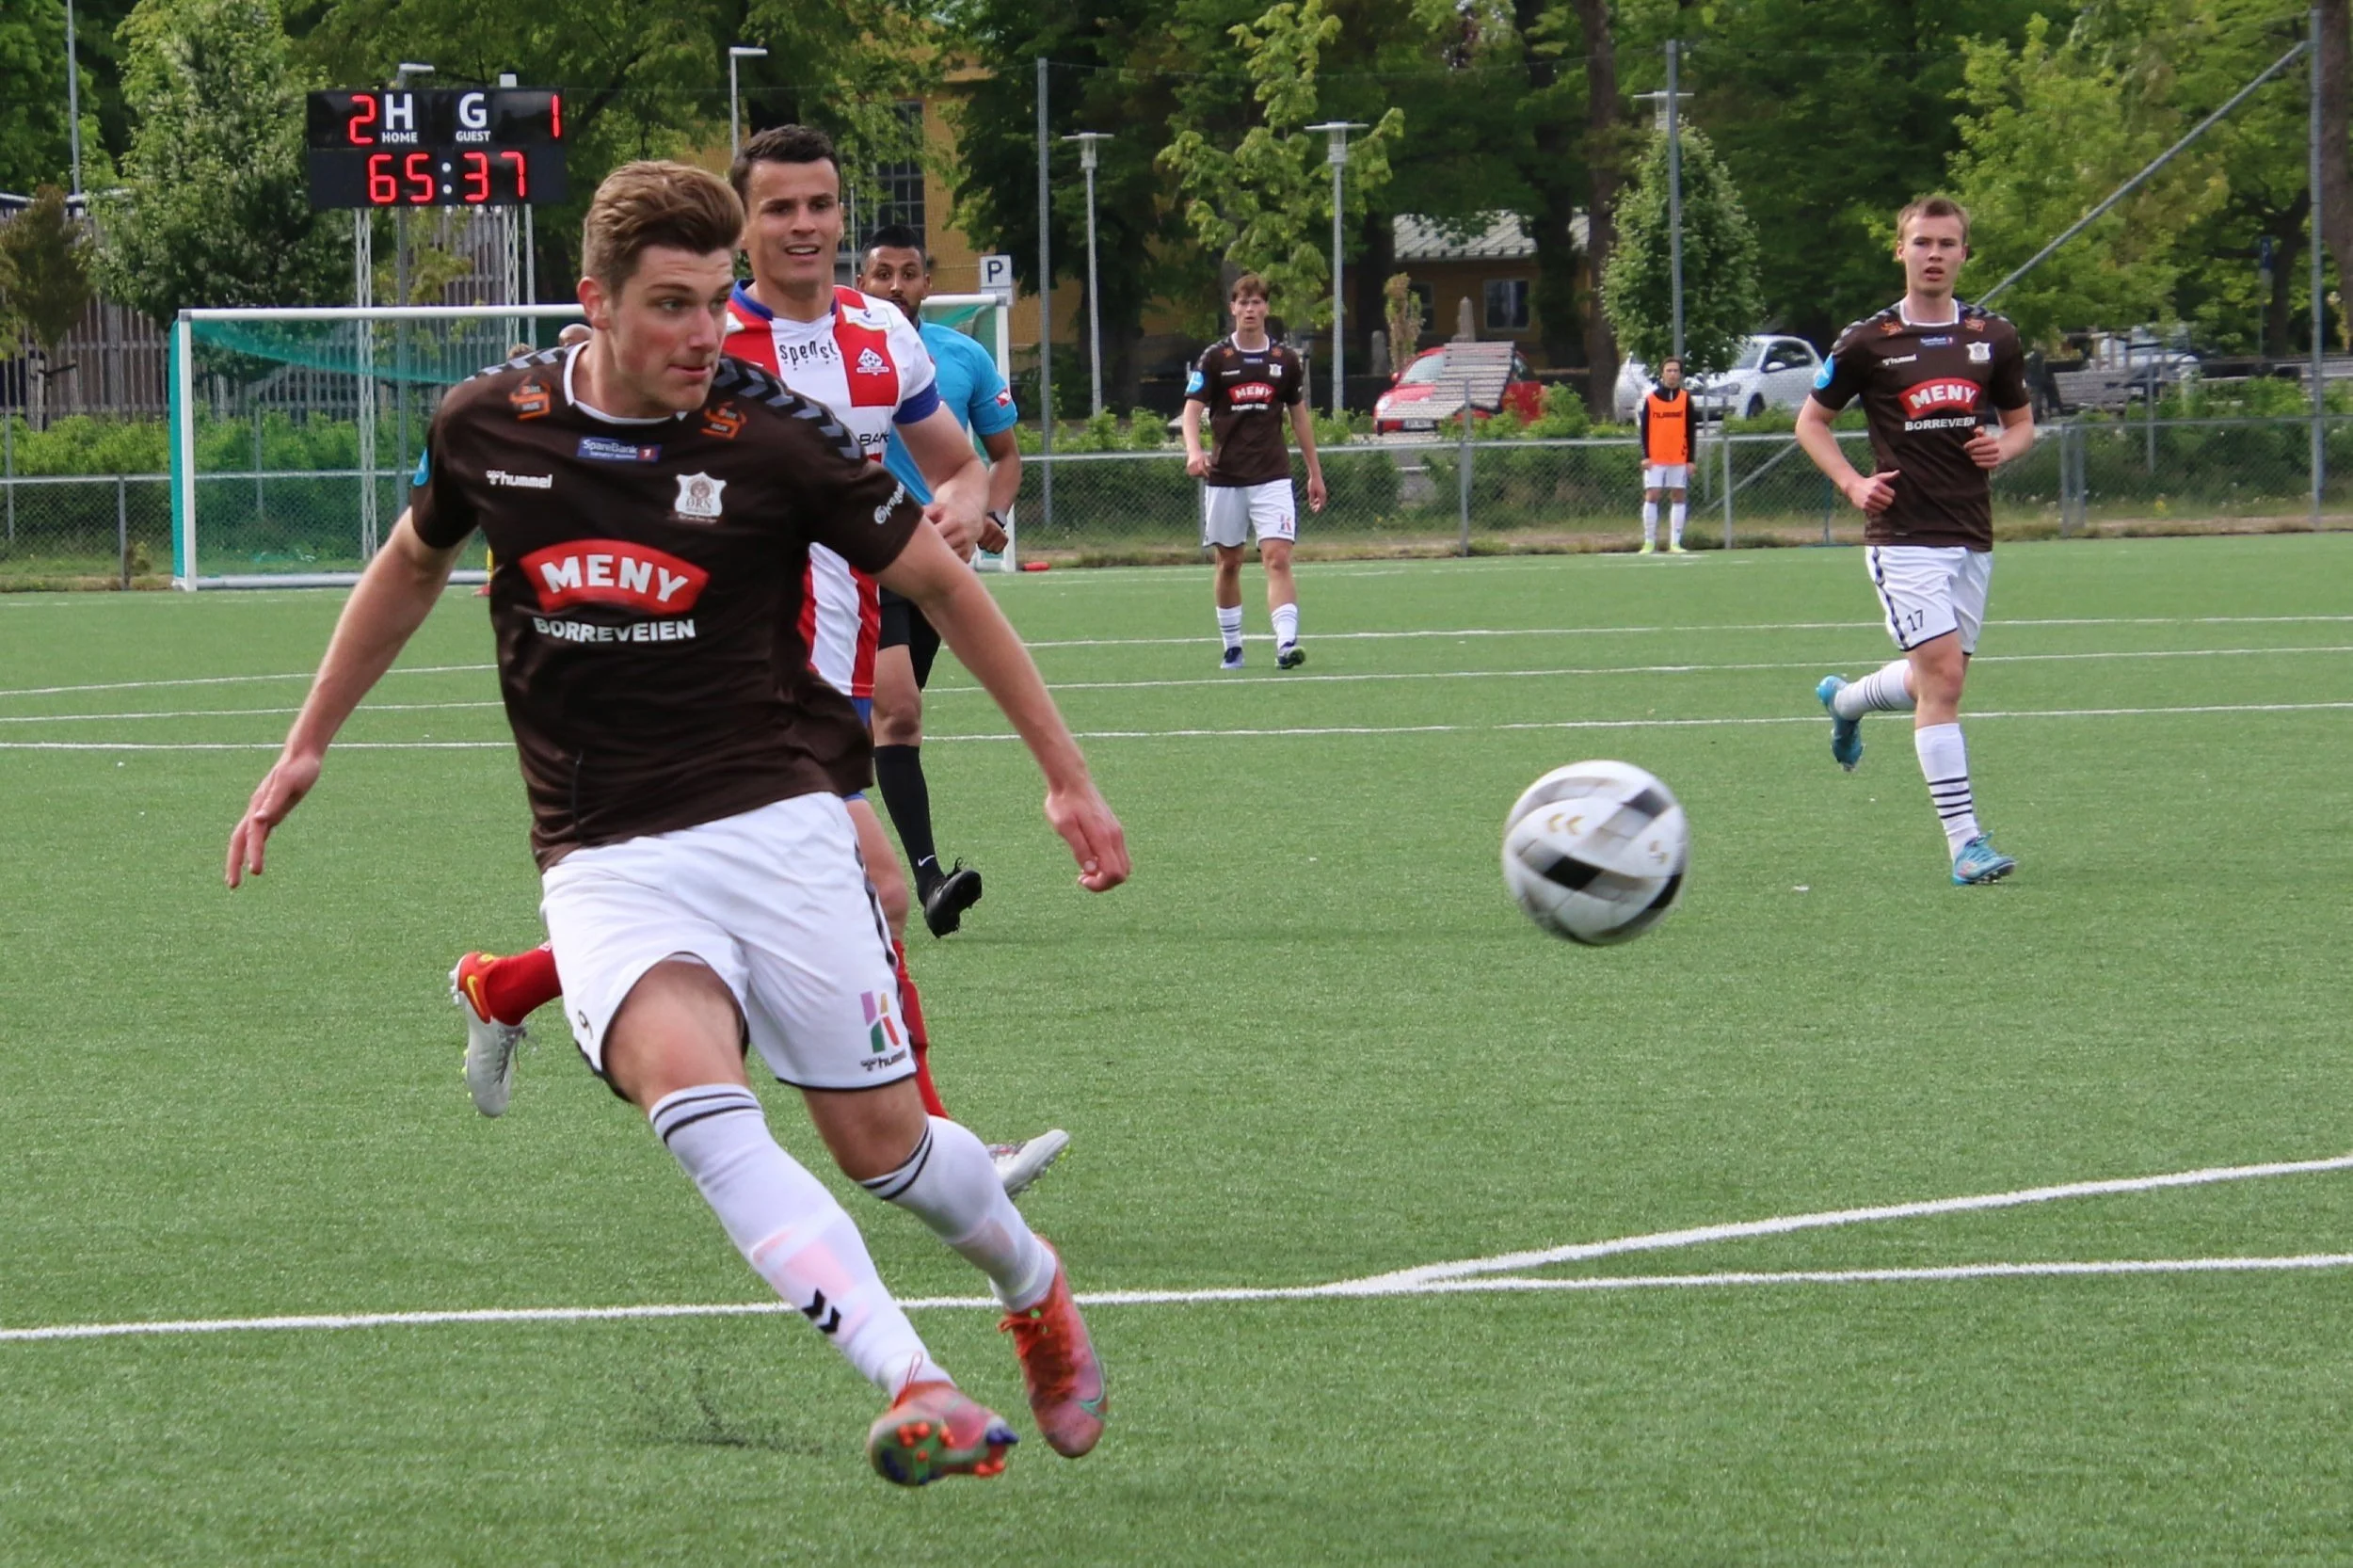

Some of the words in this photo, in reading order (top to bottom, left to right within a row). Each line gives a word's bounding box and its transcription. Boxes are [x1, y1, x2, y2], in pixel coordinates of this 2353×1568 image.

[349, 95, 376, 145] 2
[385, 93, 414, 130] H
[458, 92, 488, 129] G
[551, 93, 562, 139] 1
[381, 132, 419, 143] HOME
[456, 130, 491, 142] GUEST
[367, 152, 527, 203] 65:37
[987, 260, 1003, 283] P
[1234, 385, 1273, 399] MENY
[1909, 384, 1977, 409] MENY
[500, 470, 553, 489] hummel
[540, 553, 690, 602] MENY
[533, 616, 696, 644] BORREVEIEN
[1906, 608, 1924, 632] 17
